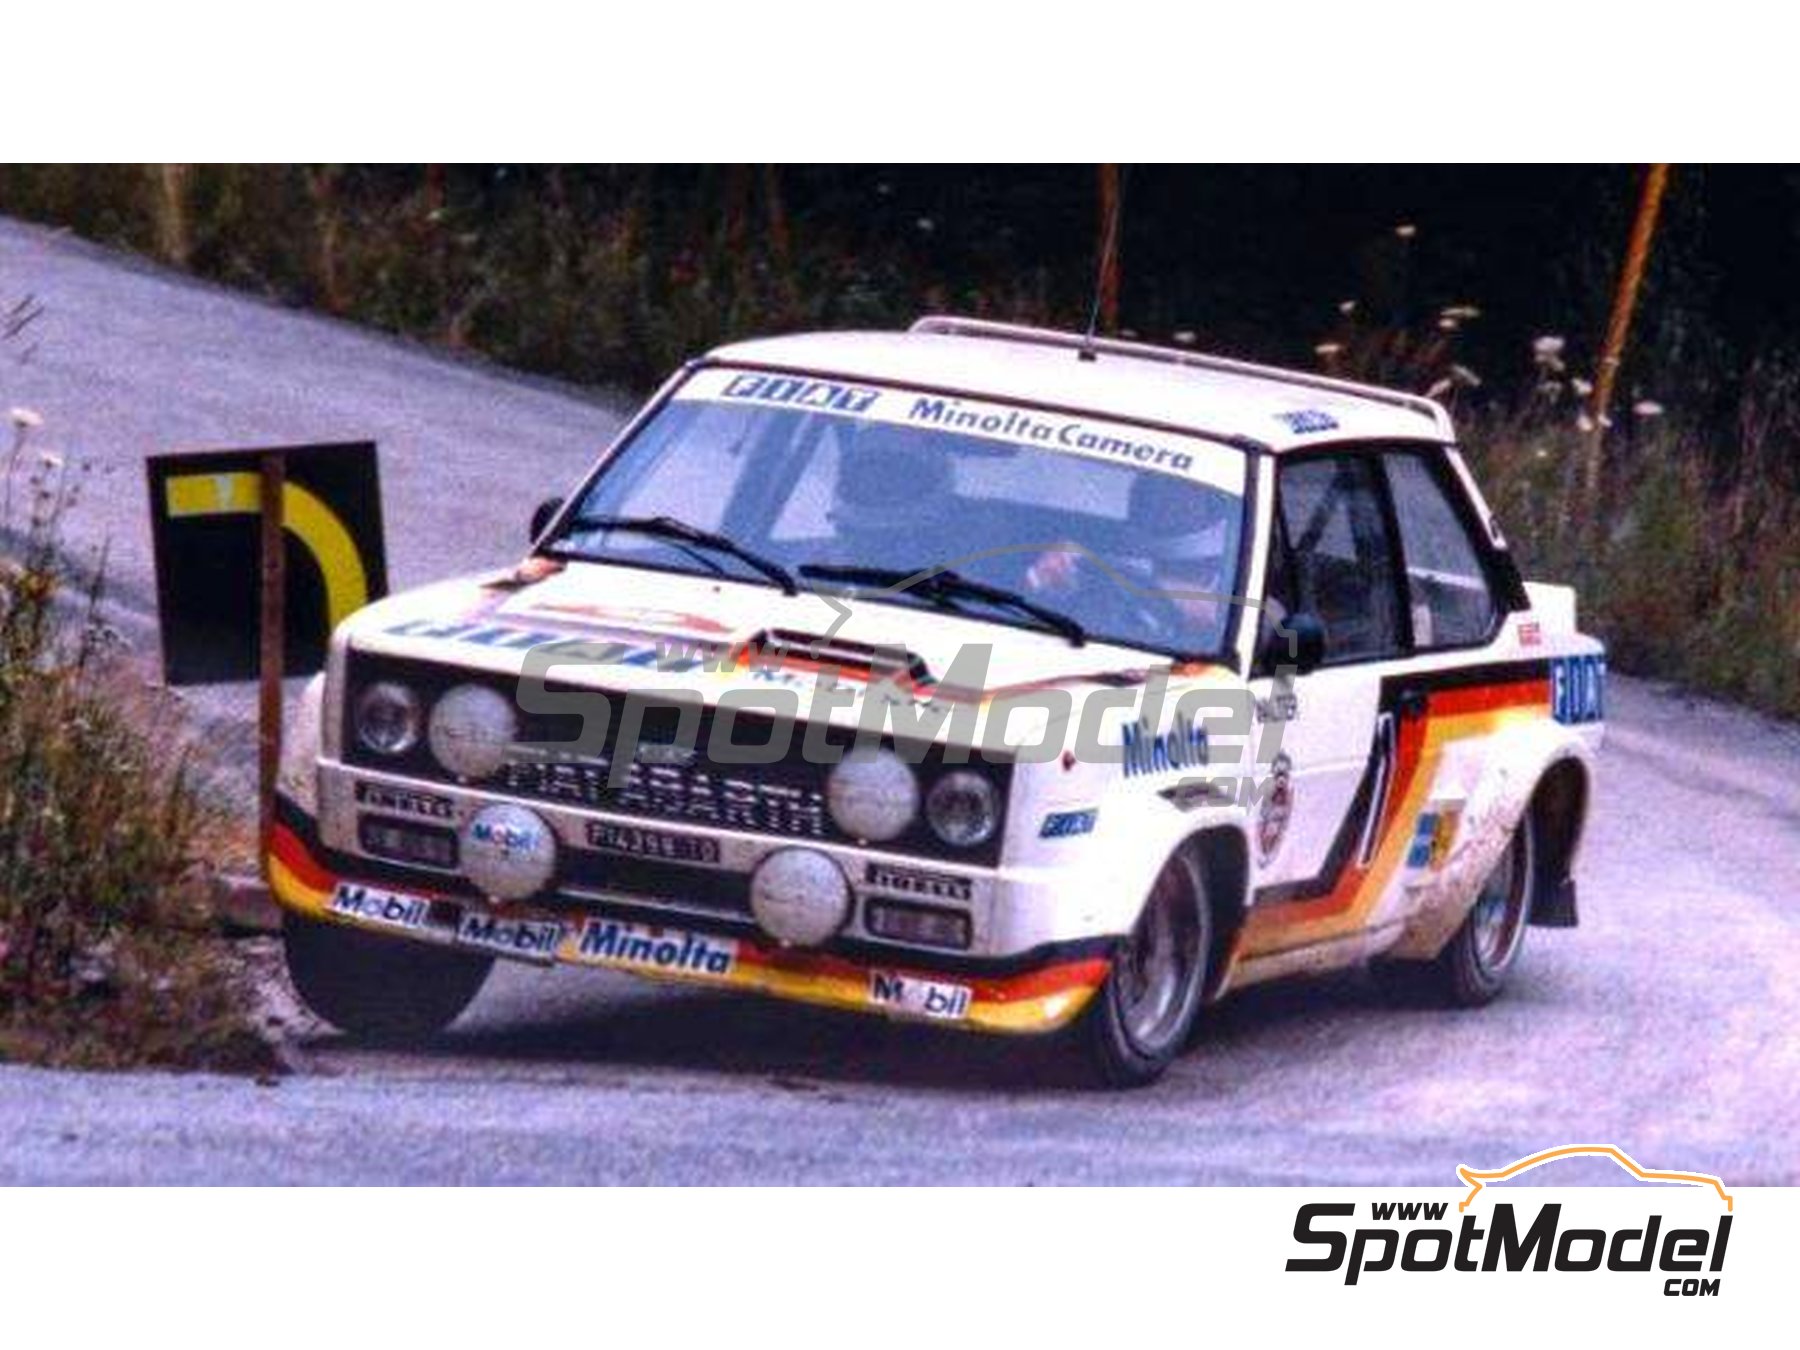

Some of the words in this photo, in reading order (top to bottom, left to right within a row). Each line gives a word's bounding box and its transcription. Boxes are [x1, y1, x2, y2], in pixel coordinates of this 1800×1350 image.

[721, 374, 882, 411] FIAT
[908, 397, 1052, 440] Minolta
[1058, 424, 1193, 470] Camera
[1122, 711, 1209, 778] Minolta
[474, 823, 537, 849] Mobil
[335, 886, 423, 925] Mobil
[462, 917, 554, 953] Mobil
[580, 922, 731, 973] Minolta
